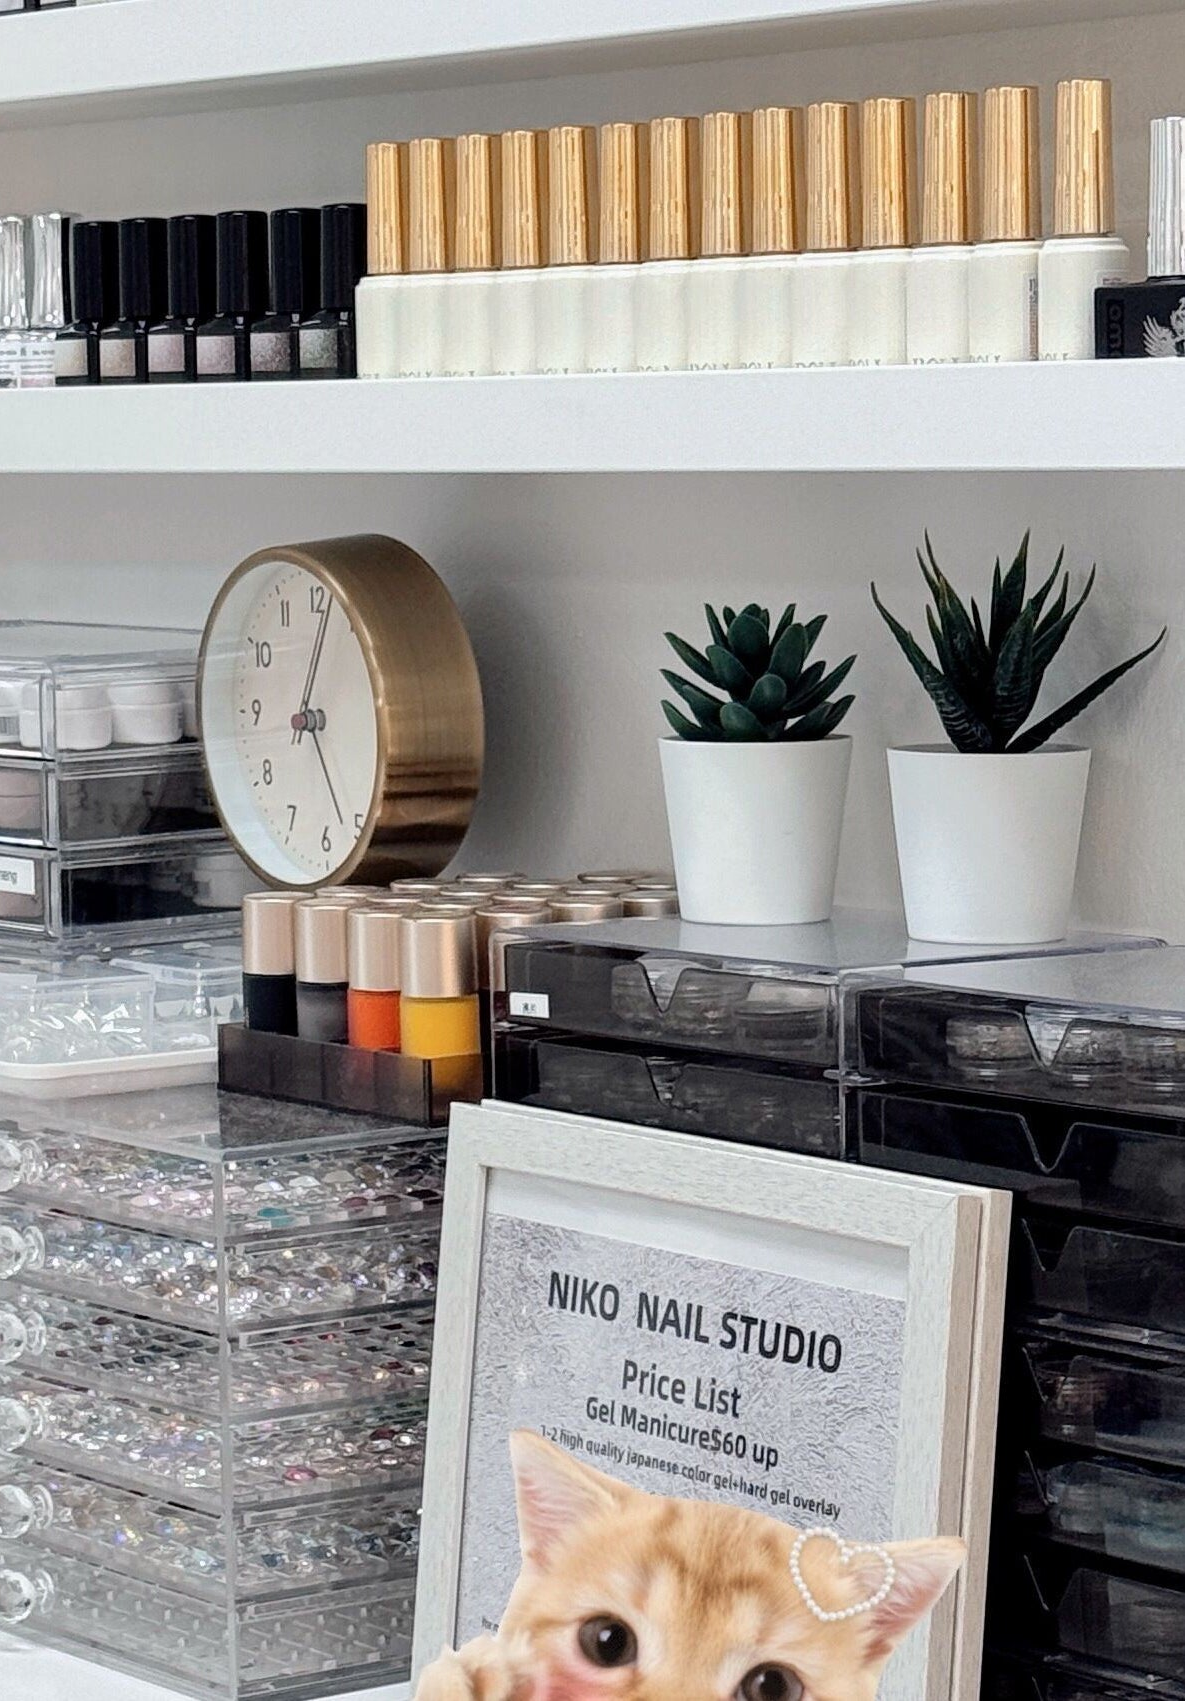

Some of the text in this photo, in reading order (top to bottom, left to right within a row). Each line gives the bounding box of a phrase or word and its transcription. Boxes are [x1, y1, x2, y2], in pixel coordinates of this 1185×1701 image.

[280, 599, 290, 628] 11
[309, 586, 325, 614] 12
[255, 641, 272, 668] 10
[251, 699, 262, 726] 9
[262, 759, 272, 785] 8
[287, 804, 297, 831] 7
[354, 813, 364, 840] 5
[321, 825, 331, 852] 6
[548, 1270, 842, 1373] NIKO NAIL STUDIO
[622, 1359, 742, 1418] Price List
[586, 1396, 615, 1425] Gel
[752, 1443, 779, 1471] up
[559, 1427, 583, 1450] high
[586, 1439, 624, 1463] quality
[626, 1447, 679, 1475] japanese
[681, 1464, 711, 1484] color
[714, 1471, 768, 1499] gel+hard
[770, 1489, 791, 1506] gel
[793, 1495, 841, 1521] overlay
